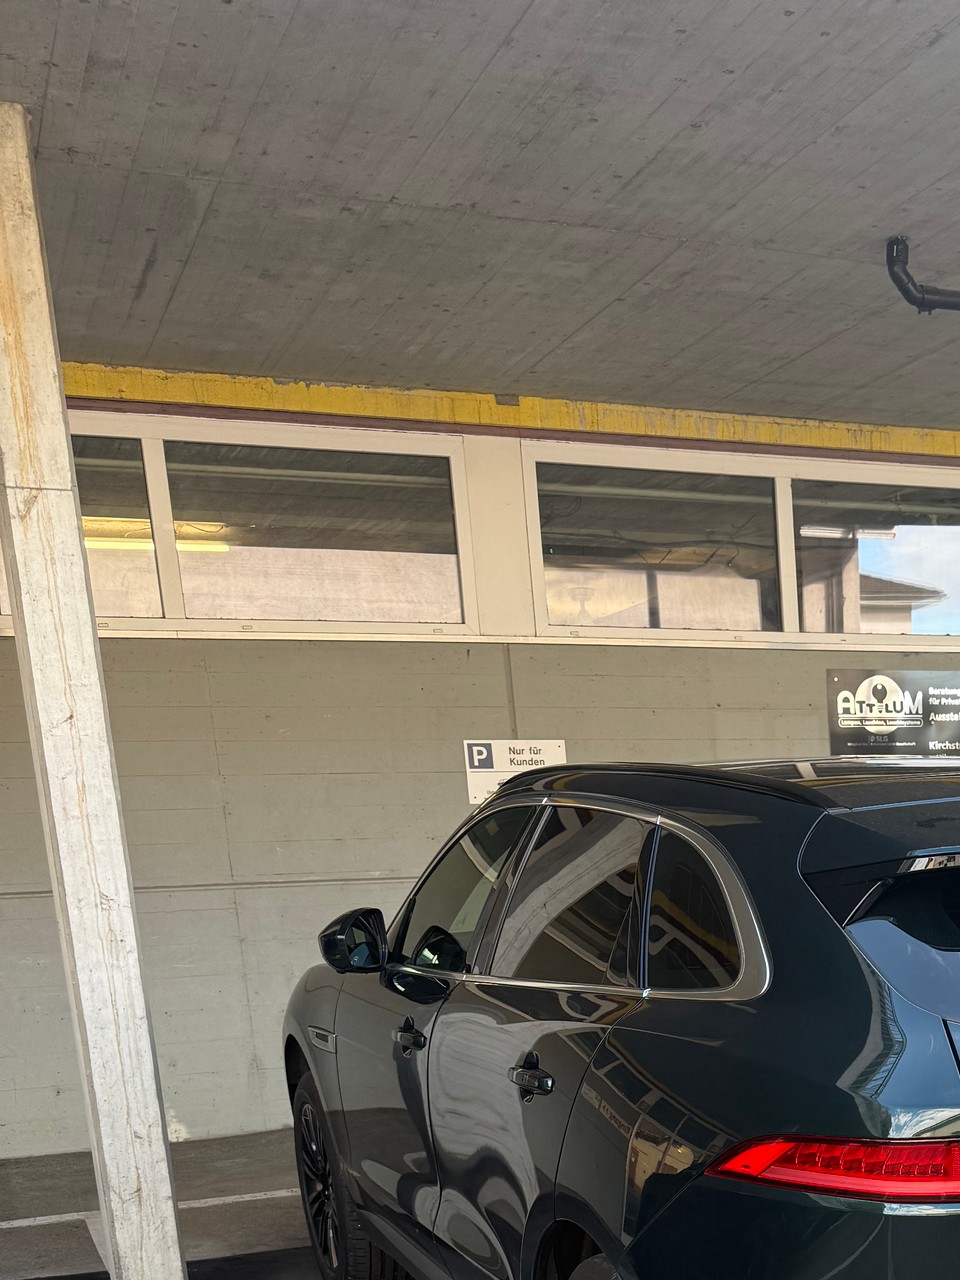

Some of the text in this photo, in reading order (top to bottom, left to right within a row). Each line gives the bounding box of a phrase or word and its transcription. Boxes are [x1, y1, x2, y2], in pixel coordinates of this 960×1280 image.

[508, 746, 542, 755] Nur für
[472, 746, 488, 766] P
[509, 758, 545, 766] Kunden
